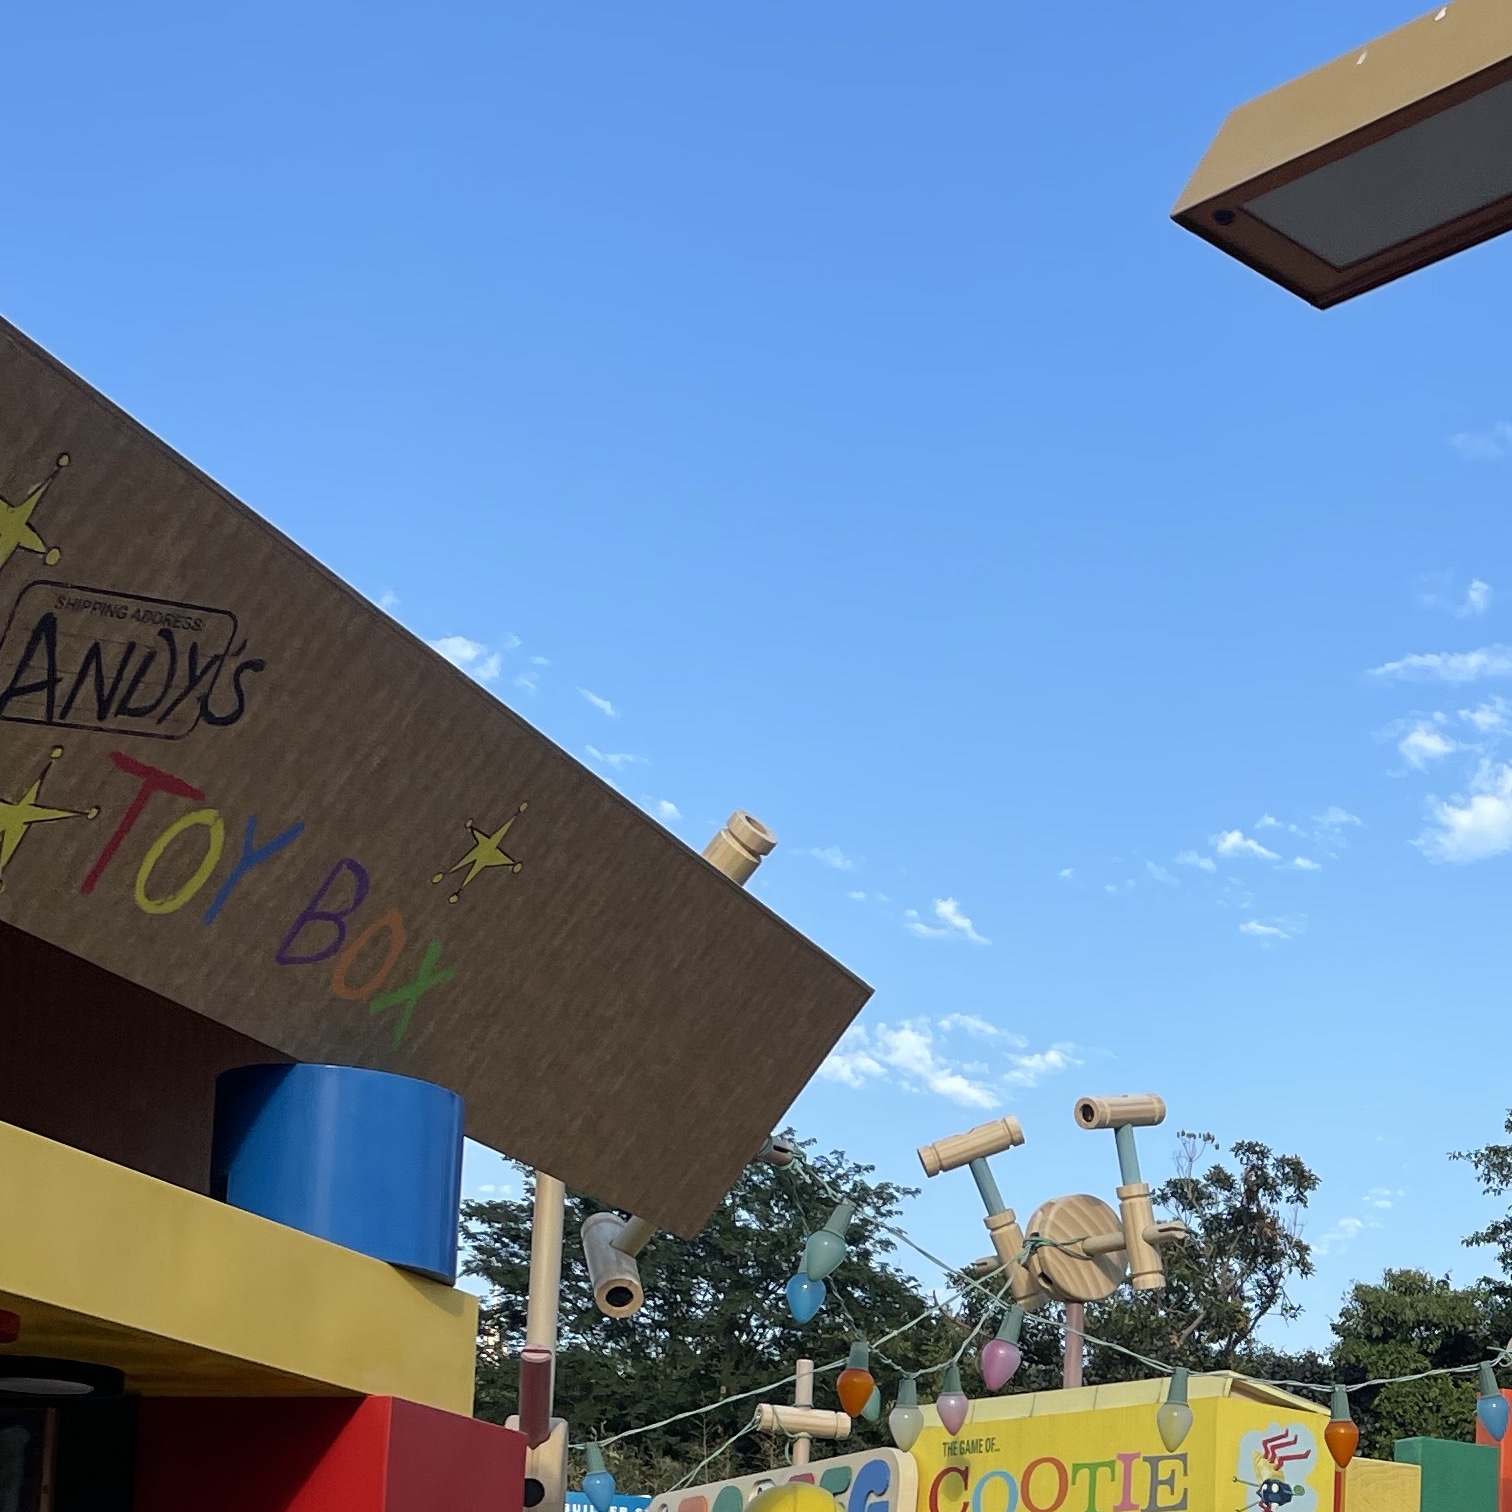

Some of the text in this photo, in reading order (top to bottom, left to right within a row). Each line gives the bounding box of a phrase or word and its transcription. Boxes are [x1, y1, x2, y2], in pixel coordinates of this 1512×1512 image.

[80, 750, 458, 1052] TOY BOX
[942, 1440, 958, 1458] THE
[959, 1437, 984, 1456] GAME
